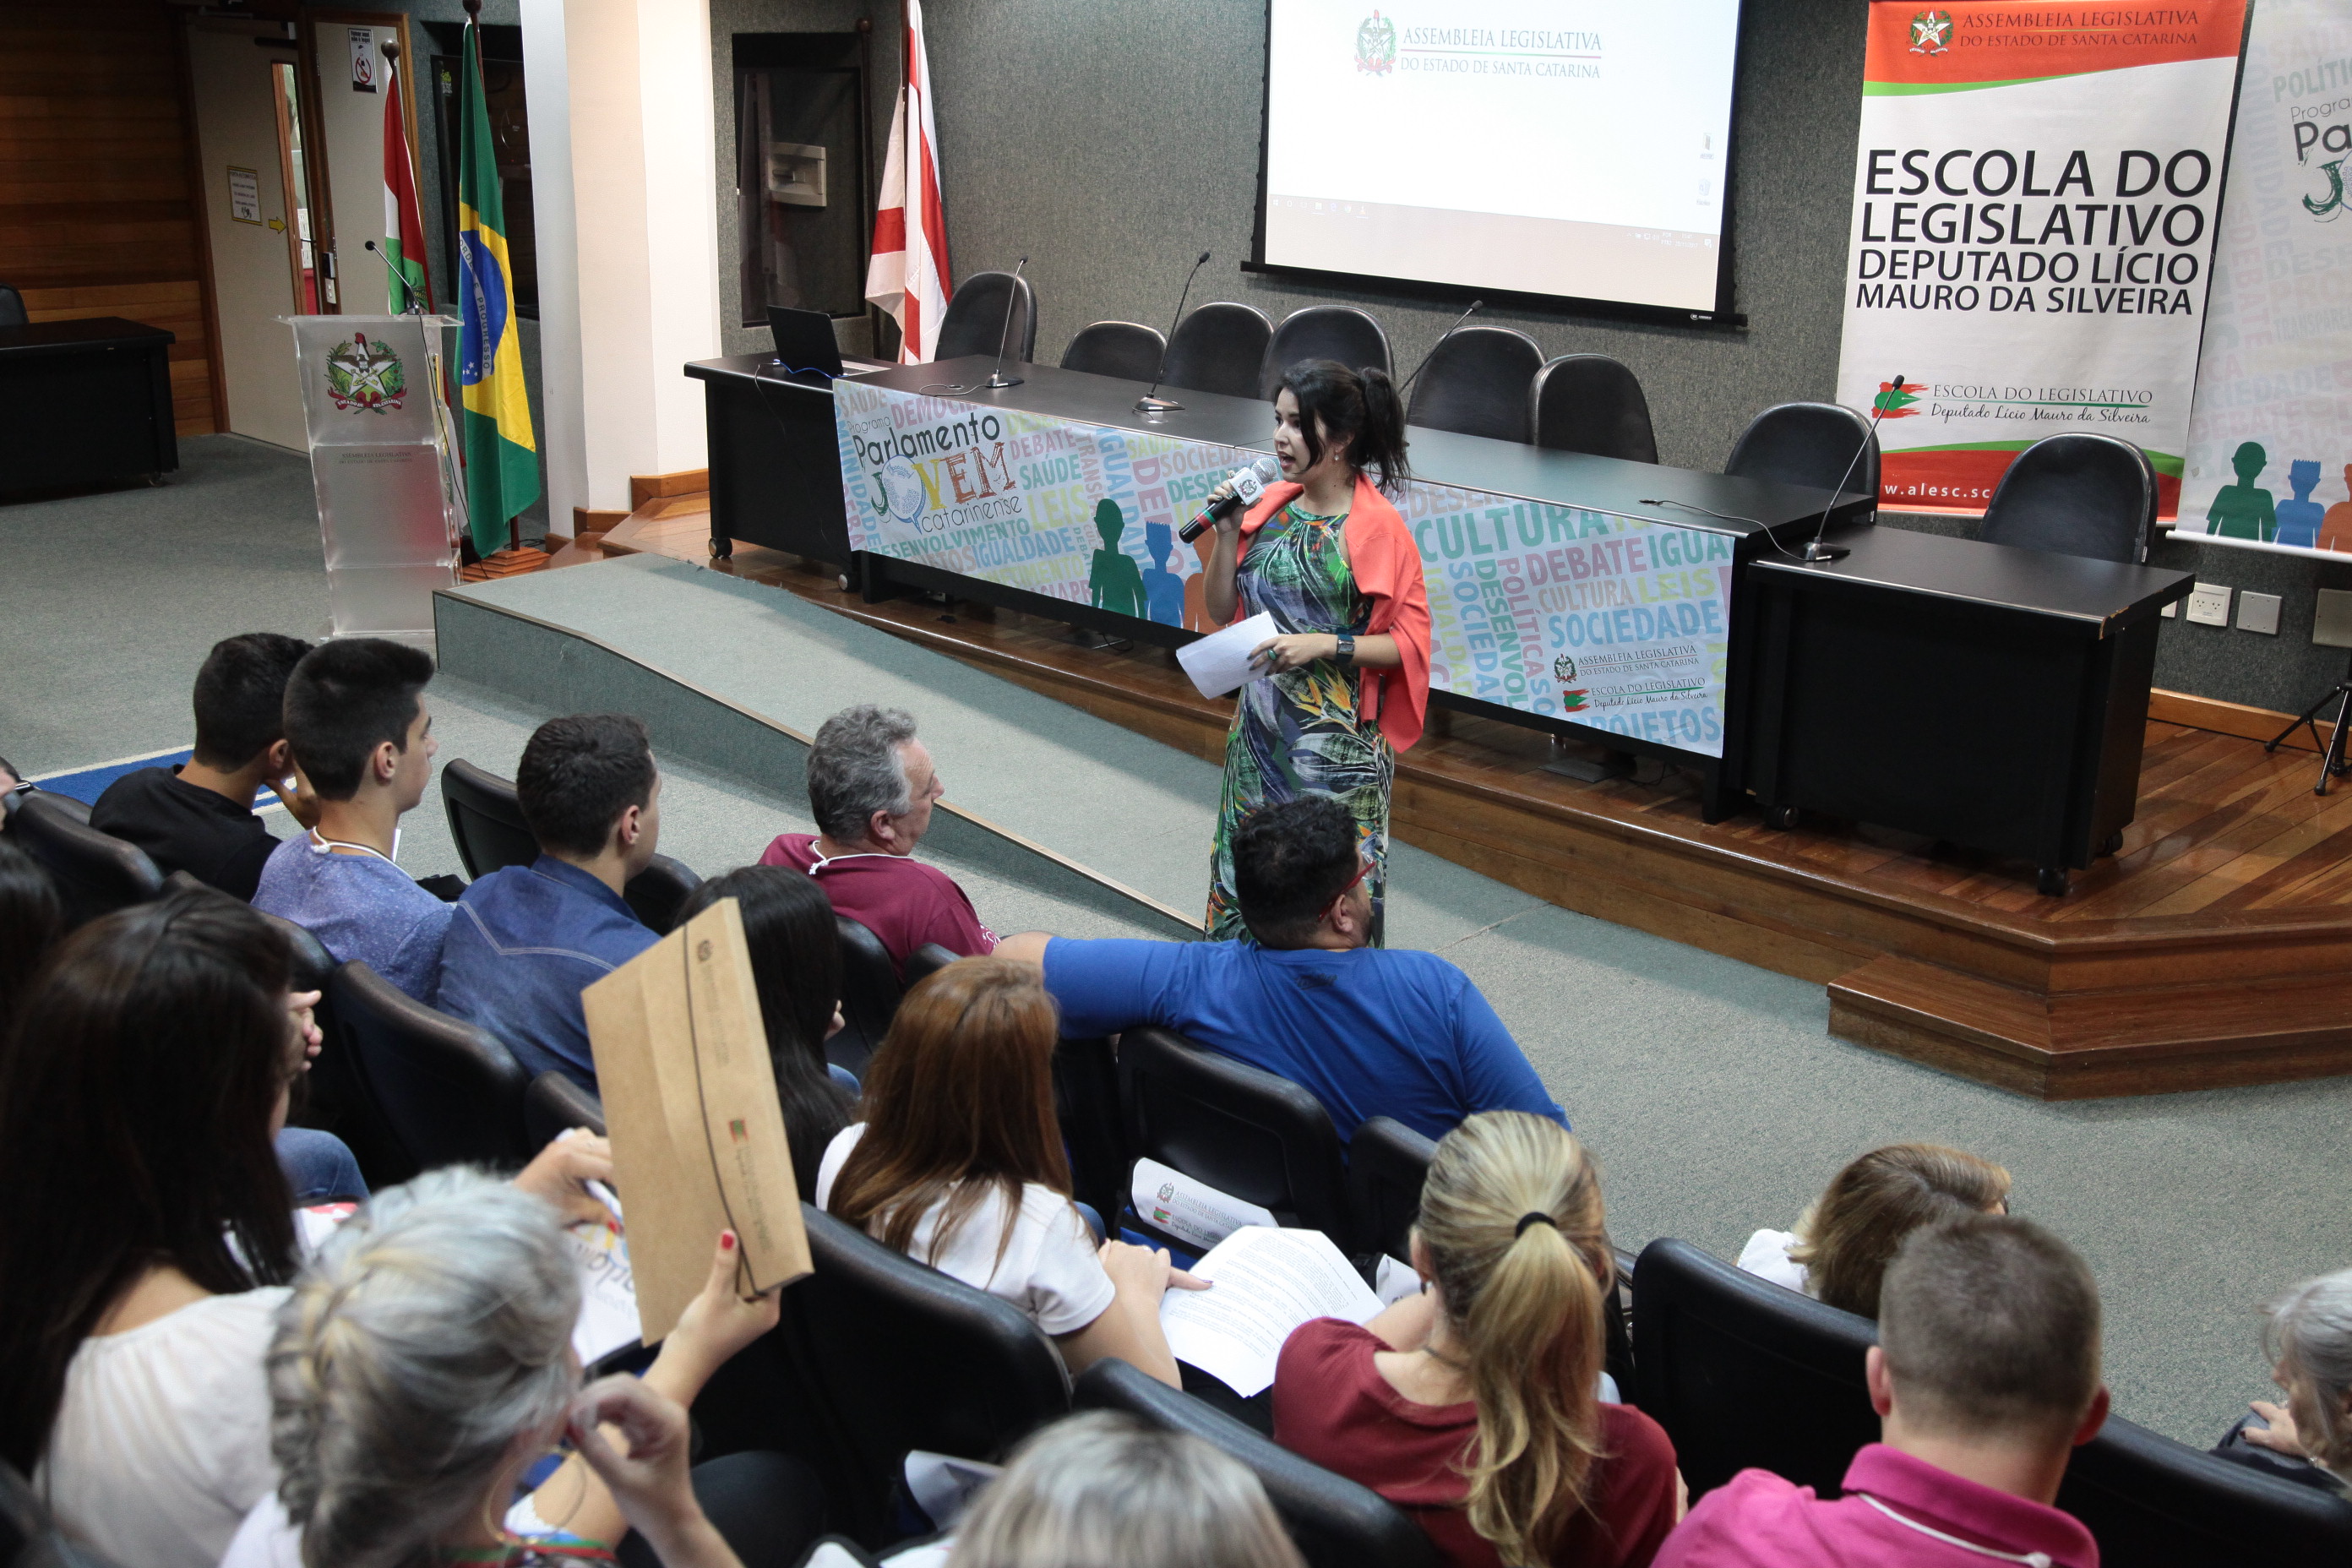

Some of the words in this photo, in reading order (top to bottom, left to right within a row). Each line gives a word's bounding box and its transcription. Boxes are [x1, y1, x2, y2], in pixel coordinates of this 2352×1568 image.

[1963, 12, 2074, 28] ASSEMBLEIA
[2081, 10, 2198, 26] LEGISLATIVA
[1403, 27, 1495, 47] ASSEMBLEIA
[1501, 30, 1602, 51] LEGISLATIVA
[1960, 35, 1982, 47] DO
[1987, 35, 2043, 47] ESTADO
[2048, 35, 2067, 46] DE
[2071, 34, 2117, 46] SANTA
[2122, 33, 2197, 45] CATARINA
[1401, 57, 1419, 70] DO
[1424, 57, 1469, 74] ESTADO
[1473, 60, 1489, 74] DE
[1492, 61, 1533, 75] SANTA
[1536, 63, 1601, 79] CATARINA
[2290, 97, 2352, 122] Progra
[2293, 120, 2352, 162] Pa
[1865, 149, 2095, 198] ESCOLA
[2115, 149, 2212, 199] DO
[1861, 202, 2205, 248] LEGISLATIVO
[1859, 248, 2079, 284] DEPUTADO
[2091, 246, 2199, 285] LÍCIO
[460, 238, 474, 270] ORDE
[477, 297, 491, 369] PROGRESSO
[1856, 283, 1980, 311] MAURO
[1990, 287, 2036, 313] DA
[2046, 287, 2193, 316] SILVEIRA
[2274, 307, 2352, 340] TRANSPARE
[1933, 384, 1997, 400] ESCOLA
[2004, 386, 2033, 400] DO
[2039, 387, 2153, 404] LEGISLATIVO
[847, 416, 892, 434] Programa
[1930, 403, 1990, 423] Deputado
[1995, 405, 2026, 421] Lício
[2028, 406, 2073, 422] Mauro
[2077, 408, 2095, 422] da
[2097, 407, 2151, 423] Silveira
[852, 412, 1000, 469] Parlamento
[1009, 427, 1077, 460] DEBATE
[1019, 454, 1082, 491] SAÚDE
[921, 496, 1022, 532] catarinense
[1026, 484, 1090, 531] LEIS
[972, 527, 1077, 568] IGUALDADE
[1414, 502, 1609, 563] CULTURA
[1647, 531, 1734, 569] IGUA
[1525, 536, 1647, 587] DEBATE
[1538, 578, 1636, 614] CULTURA
[1636, 568, 1716, 604] LEIS
[1474, 558, 1530, 712] DESENVOL
[1497, 557, 1545, 678] POLÍTICA
[1548, 599, 1723, 649] SOCIEDADE
[1578, 651, 1633, 666] ASSEMBLEIA
[1635, 645, 1697, 660] LEGISLATIVA
[1580, 668, 1592, 677] DO
[1593, 666, 1622, 676] ESTADO
[1624, 664, 1634, 672] DE
[1636, 662, 1659, 672] SANTA
[1660, 657, 1700, 669] CATARINA
[1591, 686, 1626, 696] ESCOLA
[1627, 683, 1642, 694] DO
[1645, 677, 1706, 692] LEGISLATIVO
[1594, 695, 1625, 711] Deputado
[1626, 694, 1643, 705] Lício
[1645, 694, 1669, 705] Mauro
[1669, 692, 1680, 701] da
[1680, 691, 1707, 701] Silveira
[1175, 1191, 1208, 1211] ASSEMBLEIA
[1207, 1206, 1243, 1227] LEGISLATIVA
[1180, 1200, 1198, 1213] ESTADO
